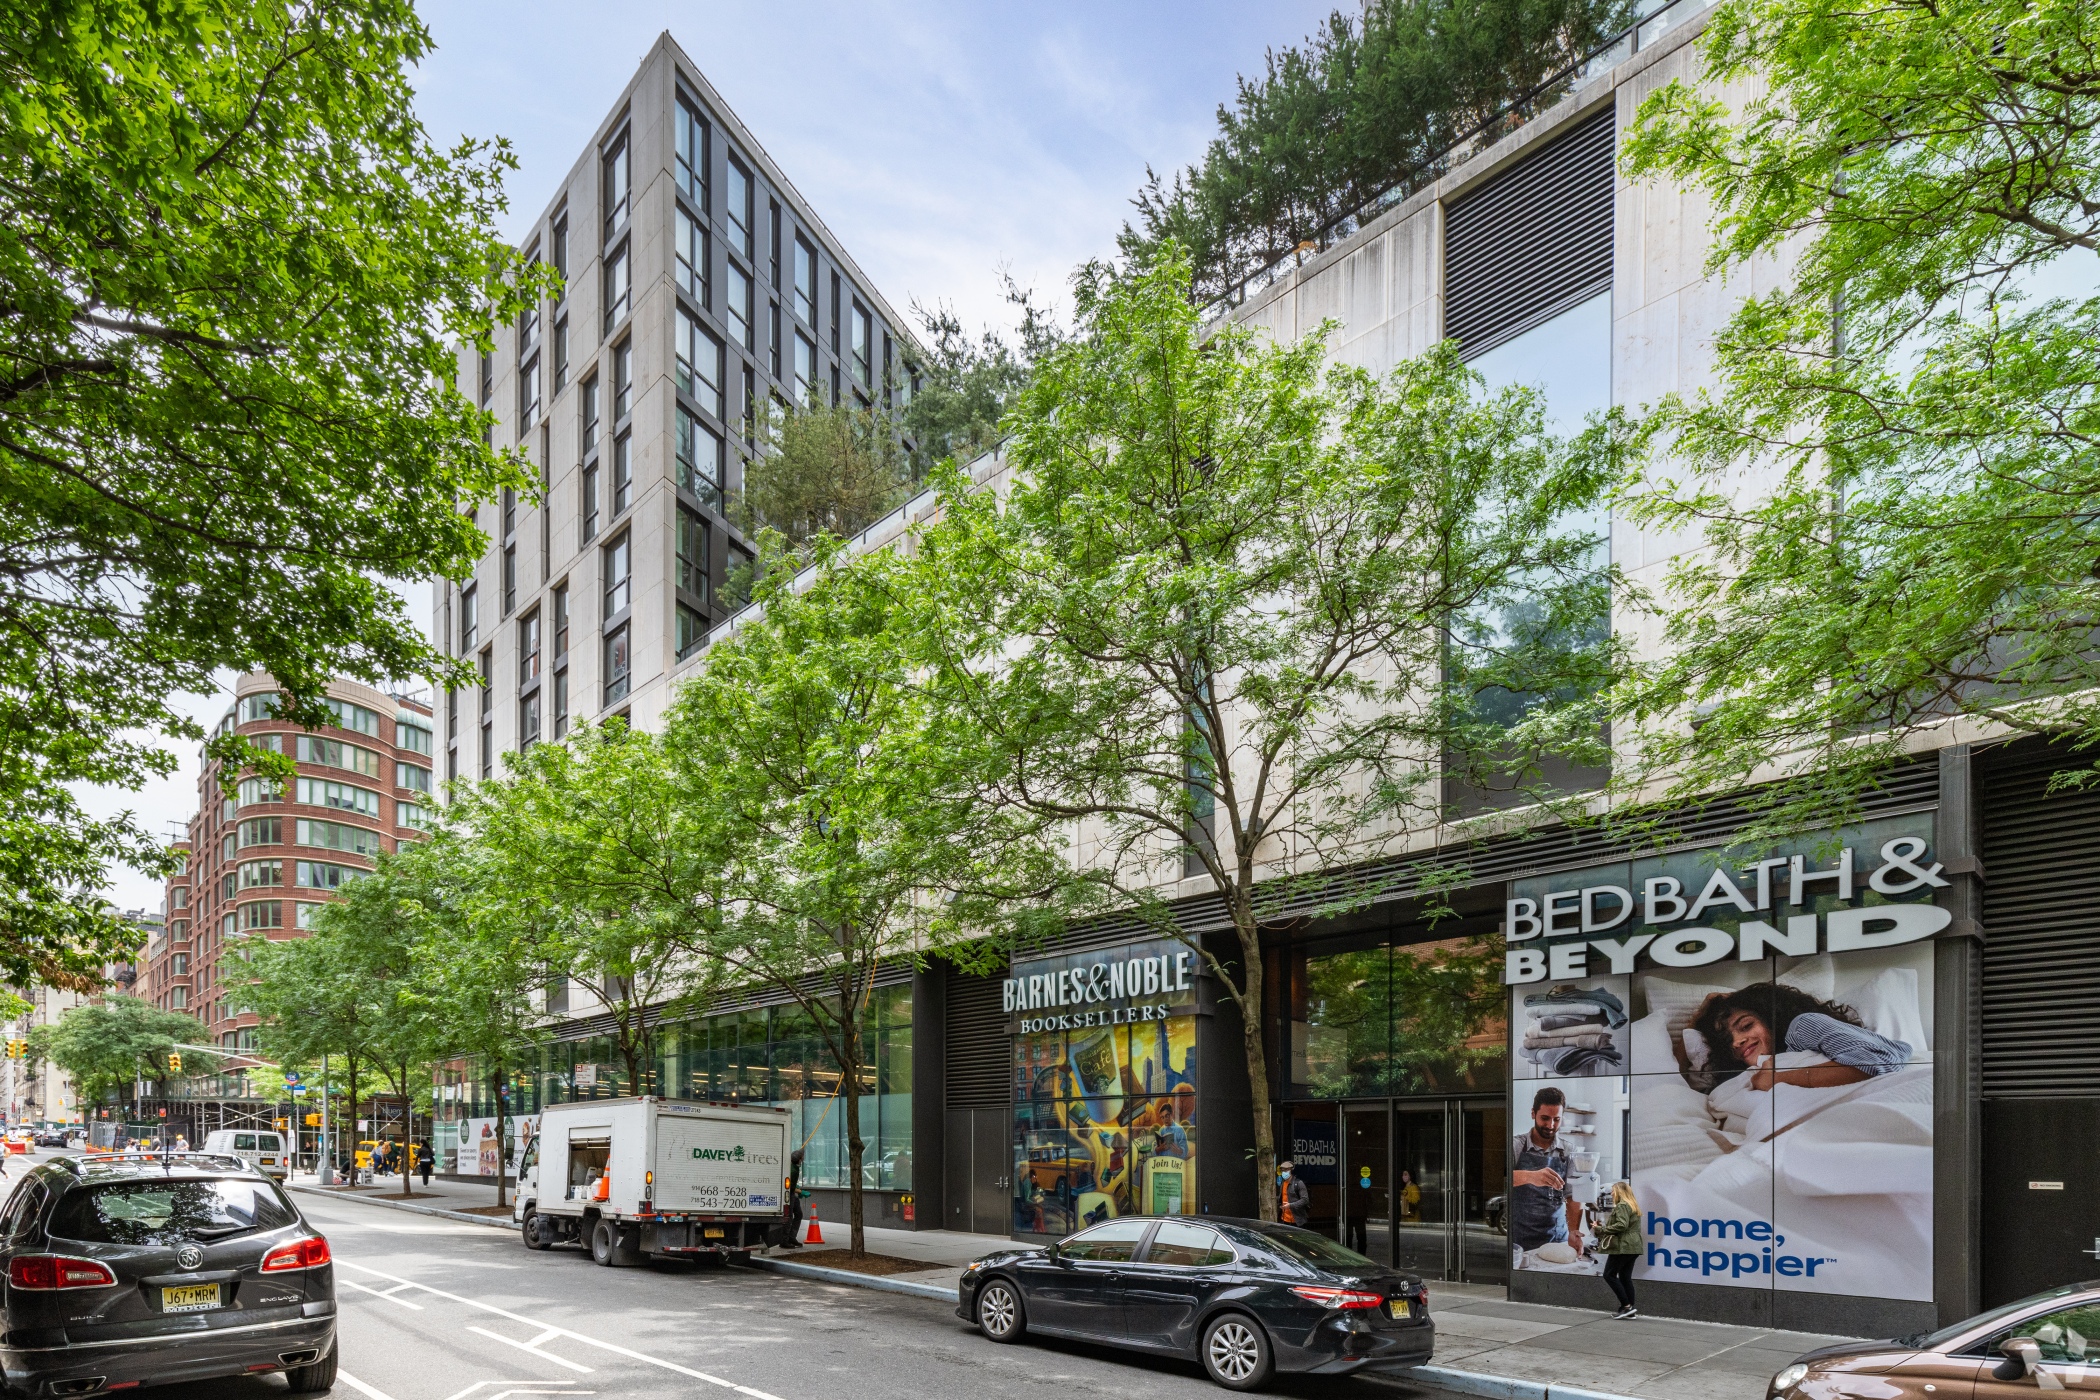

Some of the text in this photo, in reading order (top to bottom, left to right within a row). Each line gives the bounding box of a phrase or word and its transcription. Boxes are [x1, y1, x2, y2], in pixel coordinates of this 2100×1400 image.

[1506, 836, 1953, 942] BED BATH &
[1505, 903, 1953, 985] BEYOND
[1020, 1003, 1170, 1034] BOOKSELLERS
[1080, 1049, 1112, 1076] Café
[1293, 1139, 1336, 1153] BED BATH &
[693, 1148, 733, 1161] DAVEY
[747, 1152, 779, 1165] trees
[1293, 1155, 1336, 1166] BEYOND
[1152, 1159, 1183, 1169] Join Us!
[700, 1186, 747, 1197] 668-5628
[700, 1198, 747, 1209] 543-7200
[1647, 1211, 1785, 1247] home,
[167, 1288, 216, 1304] J67 MRM
